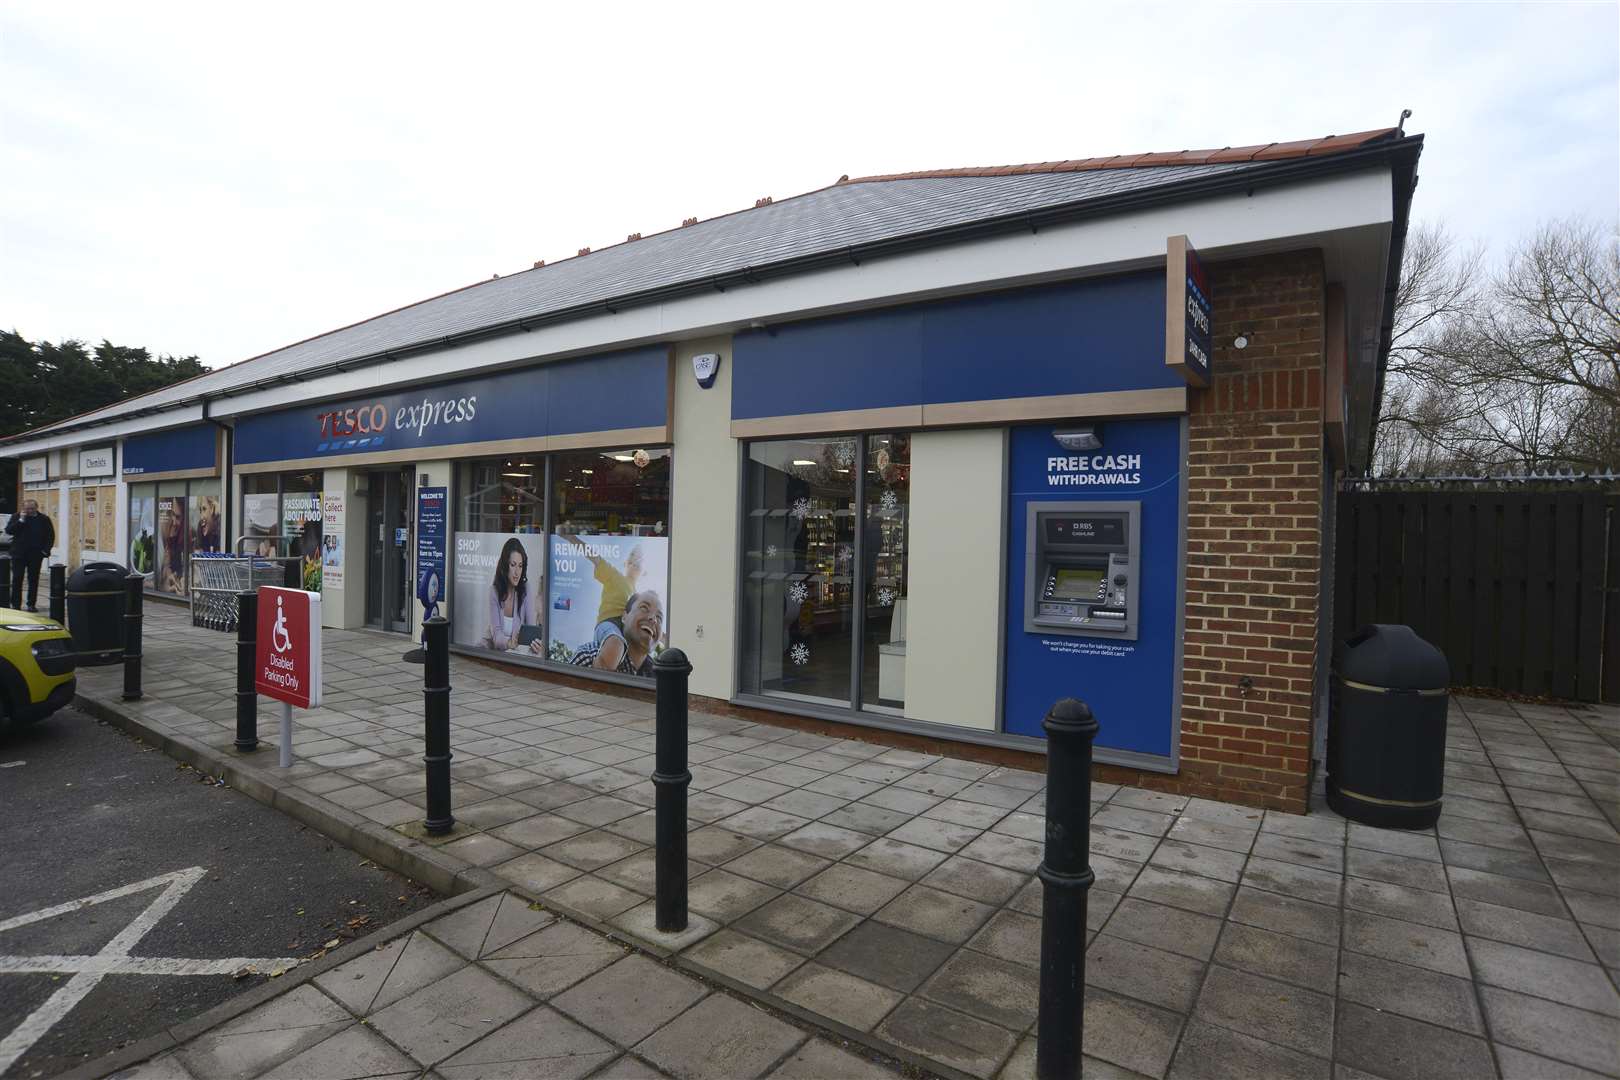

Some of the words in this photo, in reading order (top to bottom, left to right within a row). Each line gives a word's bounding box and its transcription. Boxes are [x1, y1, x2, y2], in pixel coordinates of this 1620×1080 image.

[316, 404, 387, 439] TESCO
[394, 396, 477, 437] express
[1047, 456, 1089, 471] FREE
[1091, 454, 1141, 470] CASH
[1047, 473, 1141, 485] WITHDRAWALS
[284, 498, 320, 510] PASSIONATE
[325, 502, 343, 512] Collect
[284, 510, 303, 521] ABOUT
[304, 510, 321, 521] FOOD
[325, 513, 336, 522] here
[1080, 522, 1093, 530] RBS
[458, 539, 480, 551] SHOP
[554, 543, 620, 559] REWARDING
[458, 553, 480, 566] YOUR
[554, 559, 577, 573] YOU
[270, 653, 294, 671] Disabled
[264, 667, 285, 687] Parking
[285, 673, 299, 691] Only
